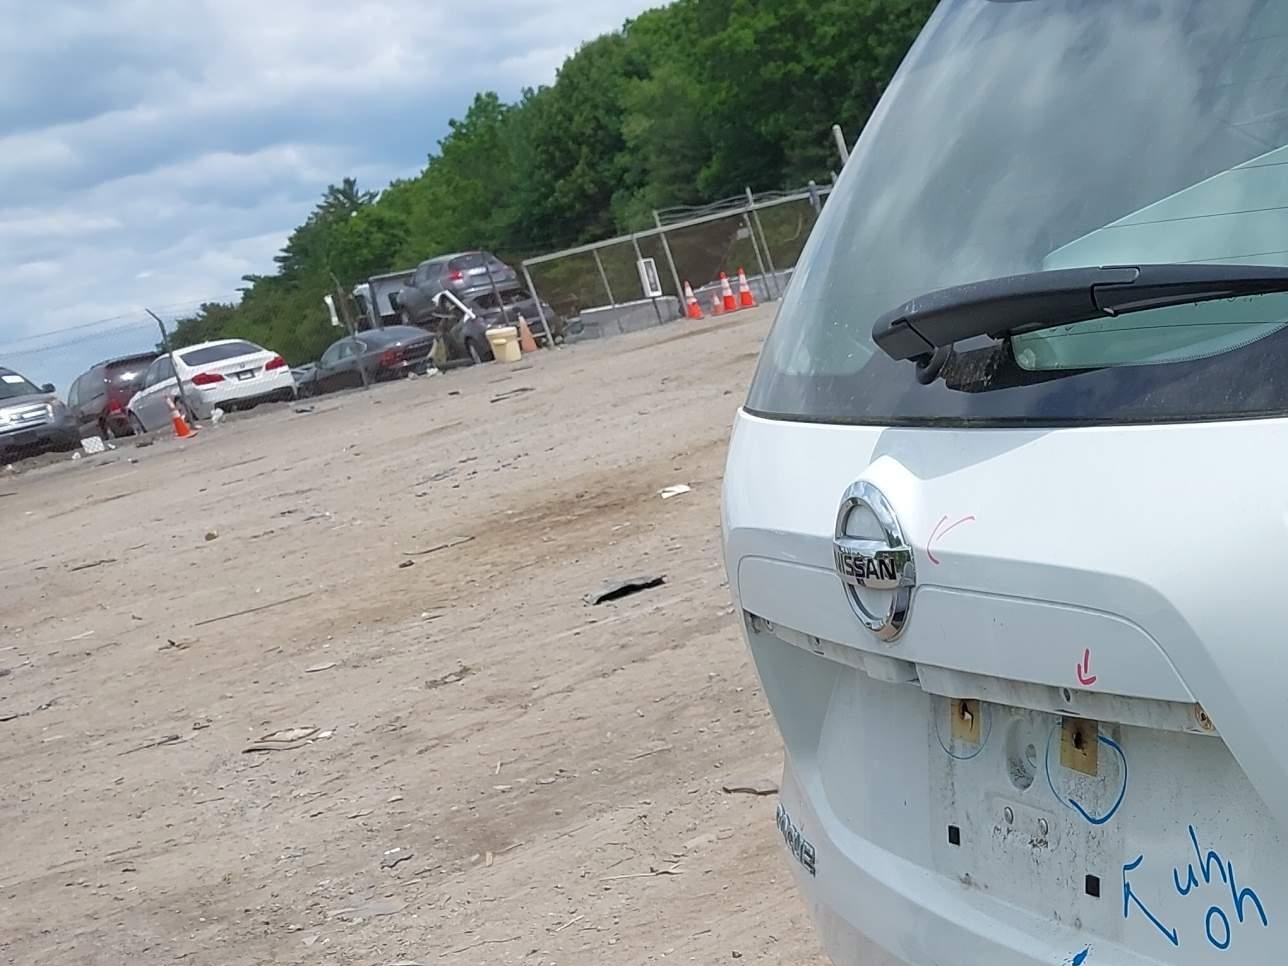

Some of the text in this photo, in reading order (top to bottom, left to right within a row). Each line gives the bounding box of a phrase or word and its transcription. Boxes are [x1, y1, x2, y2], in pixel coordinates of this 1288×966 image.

[835, 551, 898, 580] NISSAN
[1173, 824, 1227, 896] uh
[1205, 860, 1268, 950] oh
